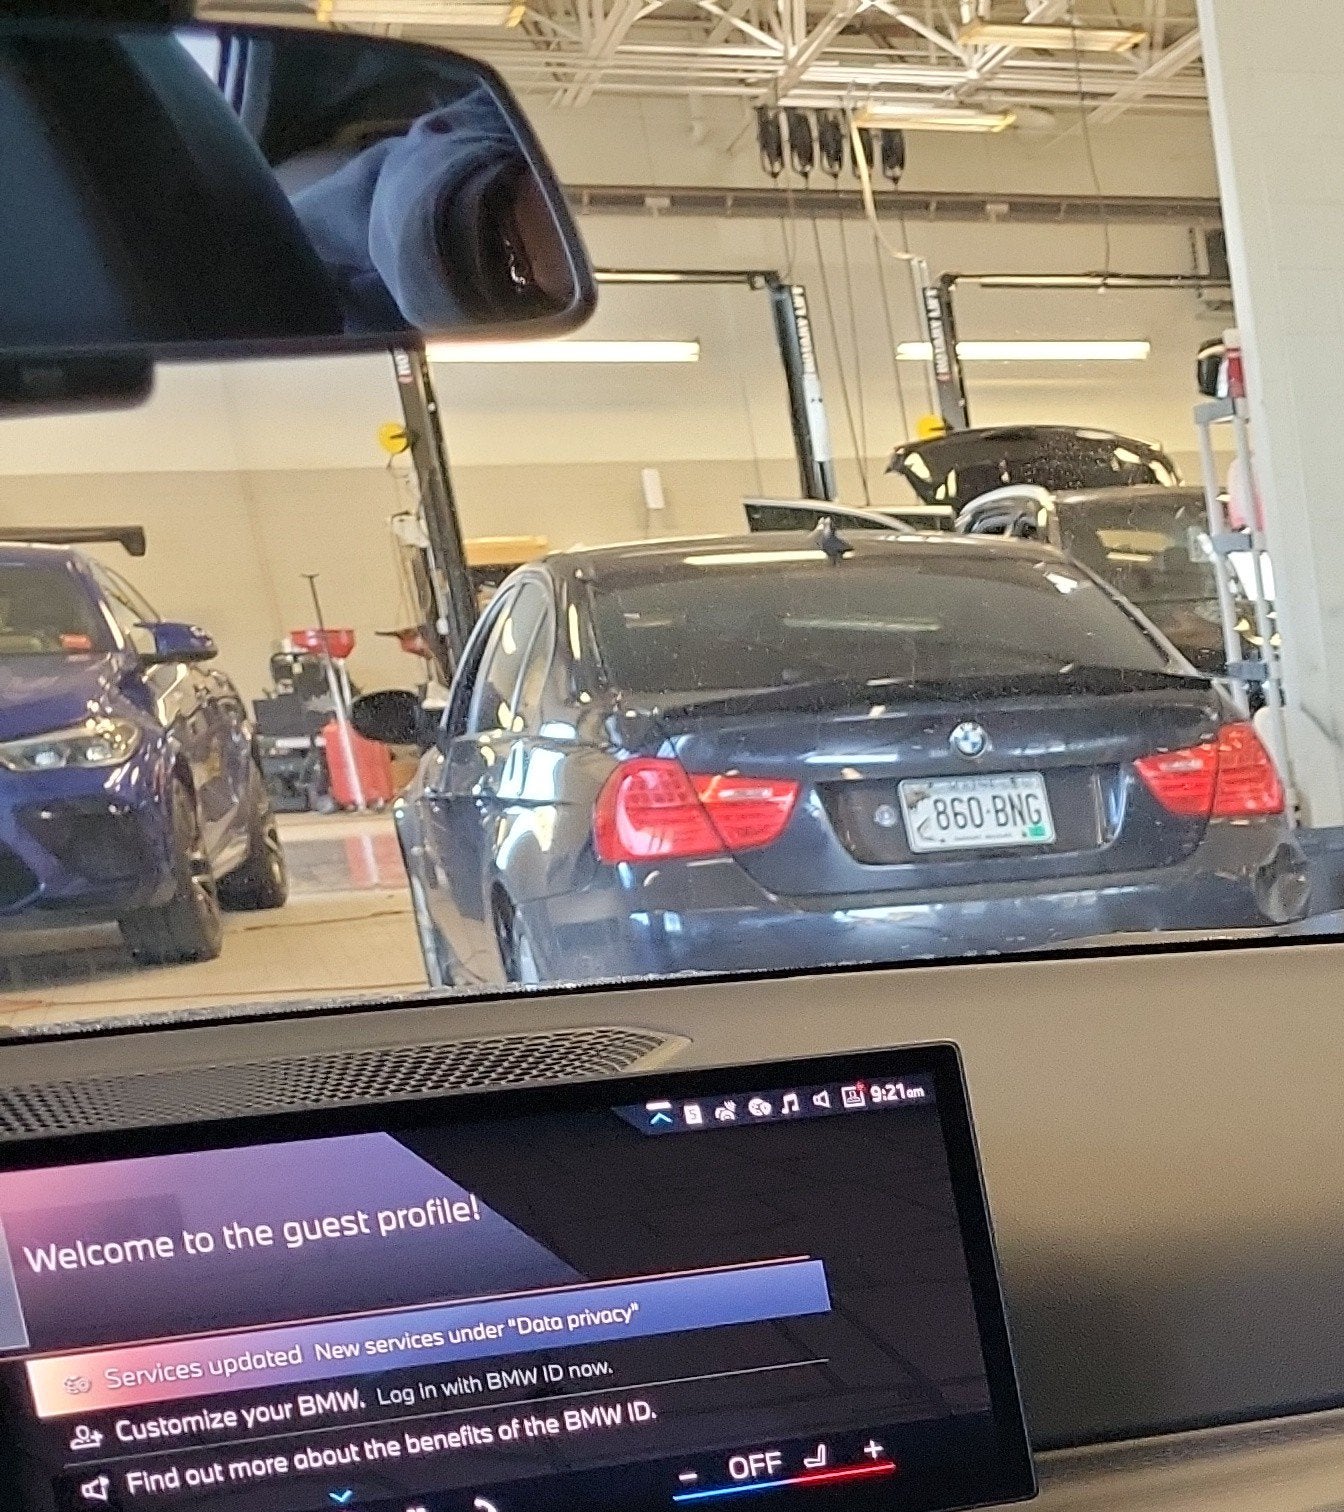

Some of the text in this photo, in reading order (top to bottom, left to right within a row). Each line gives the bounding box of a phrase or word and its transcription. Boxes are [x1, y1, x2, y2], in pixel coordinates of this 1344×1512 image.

[933, 793, 1042, 830] 860 BNG
[22, 1193, 481, 1273] Welcome to the guest profile!
[104, 1362, 203, 1388] Services
[208, 1345, 303, 1377] updated
[315, 1342, 360, 1362] New
[365, 1331, 445, 1354] services
[449, 1322, 505, 1344] under
[115, 1361, 613, 1442] Customize your BMW. Log in with BMW ID now.
[126, 1401, 658, 1495] Find out more about the benefits of the BMW ID.
[729, 1452, 782, 1479] OFF
